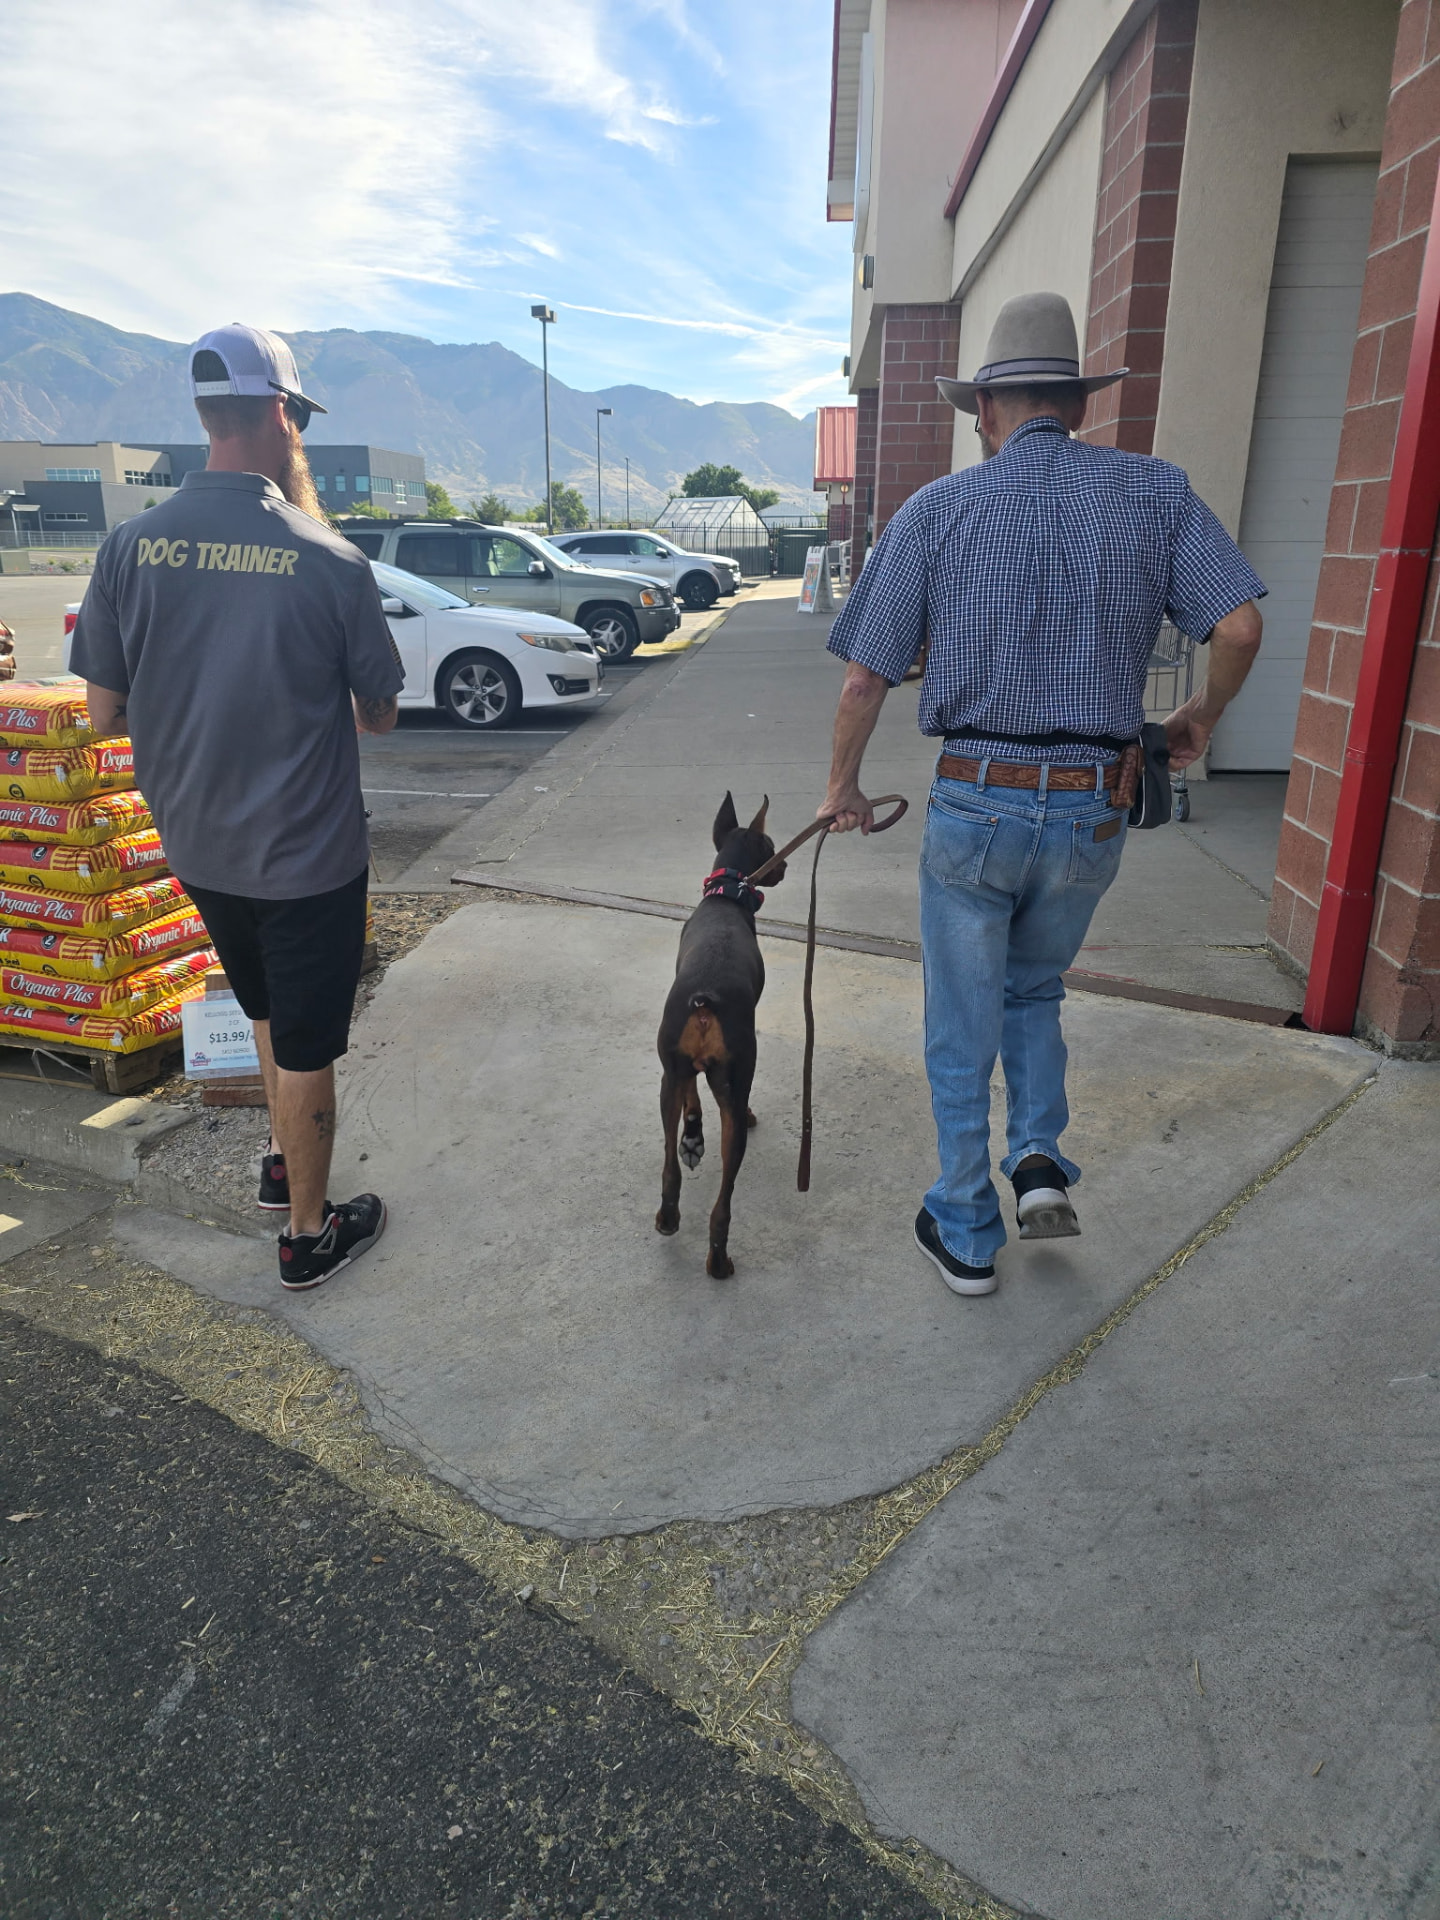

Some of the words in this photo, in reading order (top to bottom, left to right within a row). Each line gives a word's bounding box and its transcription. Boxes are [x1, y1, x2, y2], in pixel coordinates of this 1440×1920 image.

[137, 537, 189, 568] DOG
[196, 542, 299, 576] TRAINER
[6, 708, 39, 729] Plus
[29, 806, 60, 828] Plus
[43, 900, 75, 921] Plus
[138, 926, 181, 953] Organic
[10, 974, 61, 997] Organic
[64, 983, 95, 1004] Plus
